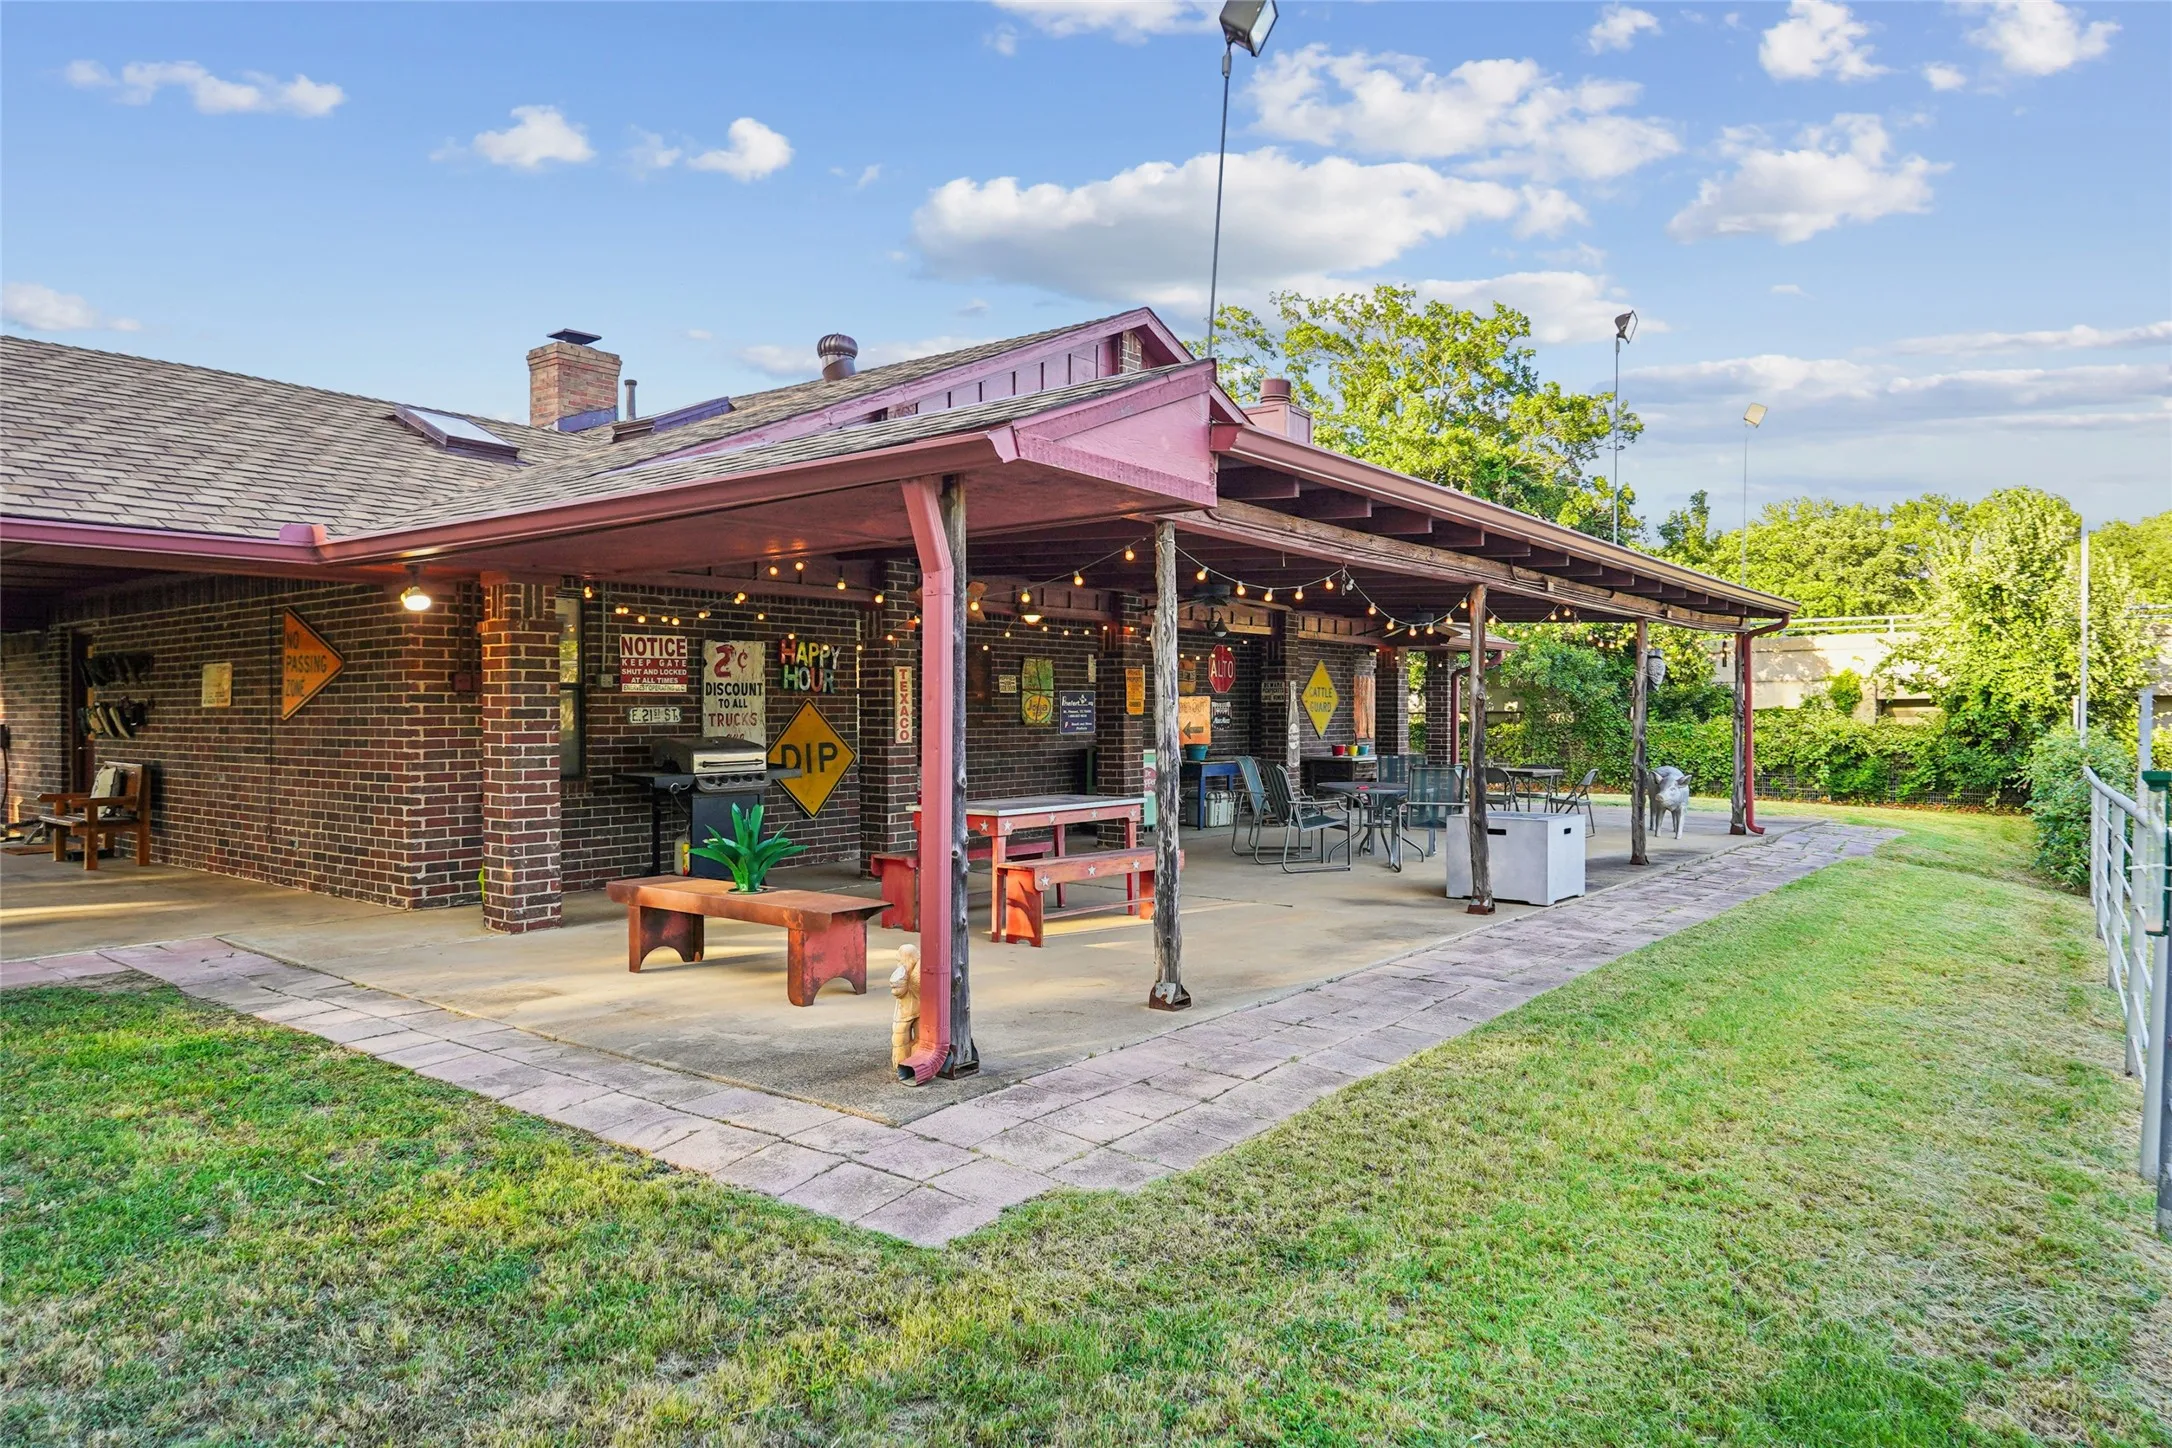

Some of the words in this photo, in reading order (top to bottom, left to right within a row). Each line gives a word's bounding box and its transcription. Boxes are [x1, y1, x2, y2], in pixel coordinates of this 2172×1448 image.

[285, 631, 300, 649] NO
[621, 636, 687, 657] NOTICE
[621, 658, 652, 667] KEEP
[658, 659, 687, 667] GATE
[780, 639, 842, 670] HAPPY
[285, 655, 327, 674] PASSING
[621, 668, 642, 676] SHUT
[643, 668, 658, 676] AND
[1210, 659, 1234, 678] ALTO
[285, 679, 304, 697] ZONE
[783, 664, 836, 694] HOUR
[705, 682, 763, 696] DISCOUNT
[1309, 687, 1333, 698] CATTLE
[718, 698, 731, 709] TO
[732, 699, 748, 708] ALL
[899, 668, 910, 741] TEXACO
[1309, 701, 1332, 712] GUARD
[708, 711, 758, 727] TRUCKS
[781, 742, 838, 774] DIP
